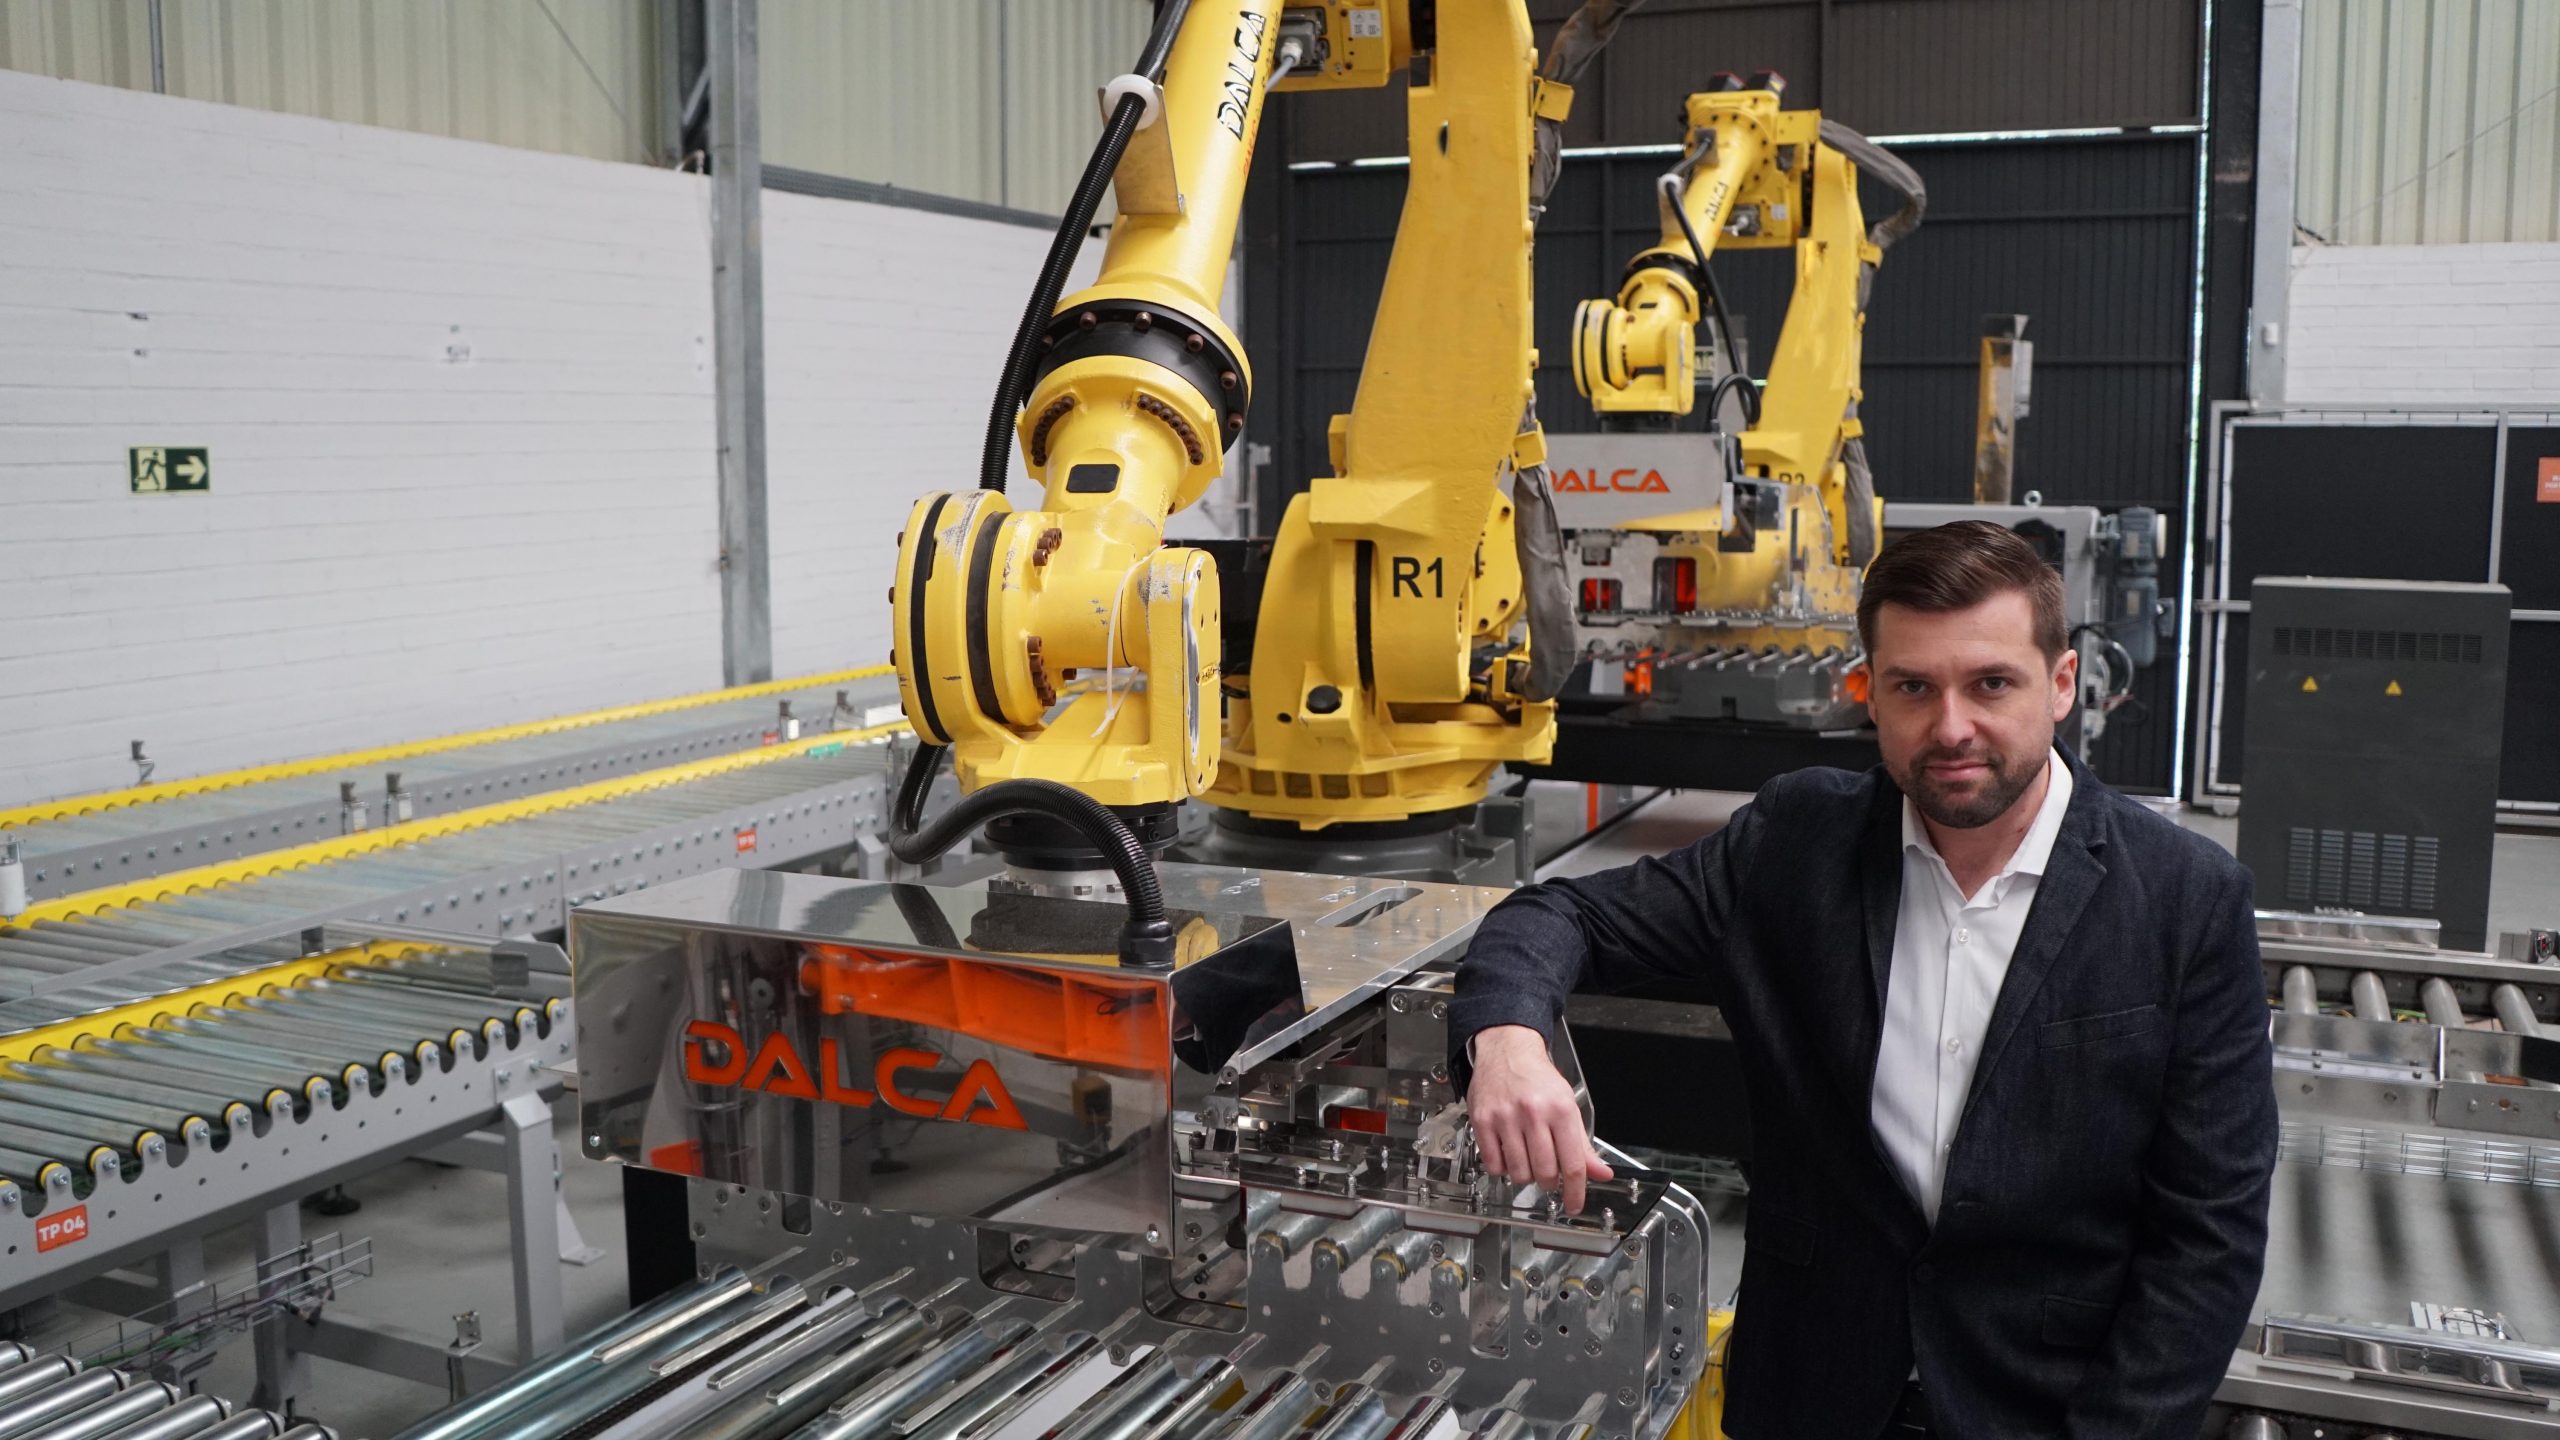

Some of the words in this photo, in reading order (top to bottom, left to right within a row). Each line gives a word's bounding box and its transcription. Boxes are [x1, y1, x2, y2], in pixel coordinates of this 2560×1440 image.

[1217, 10, 1267, 142] DALCA
[1392, 556, 1443, 598] R1
[685, 1019, 1030, 1132] DALCA
[39, 1223, 61, 1242] TP
[63, 1215, 86, 1235] 04
